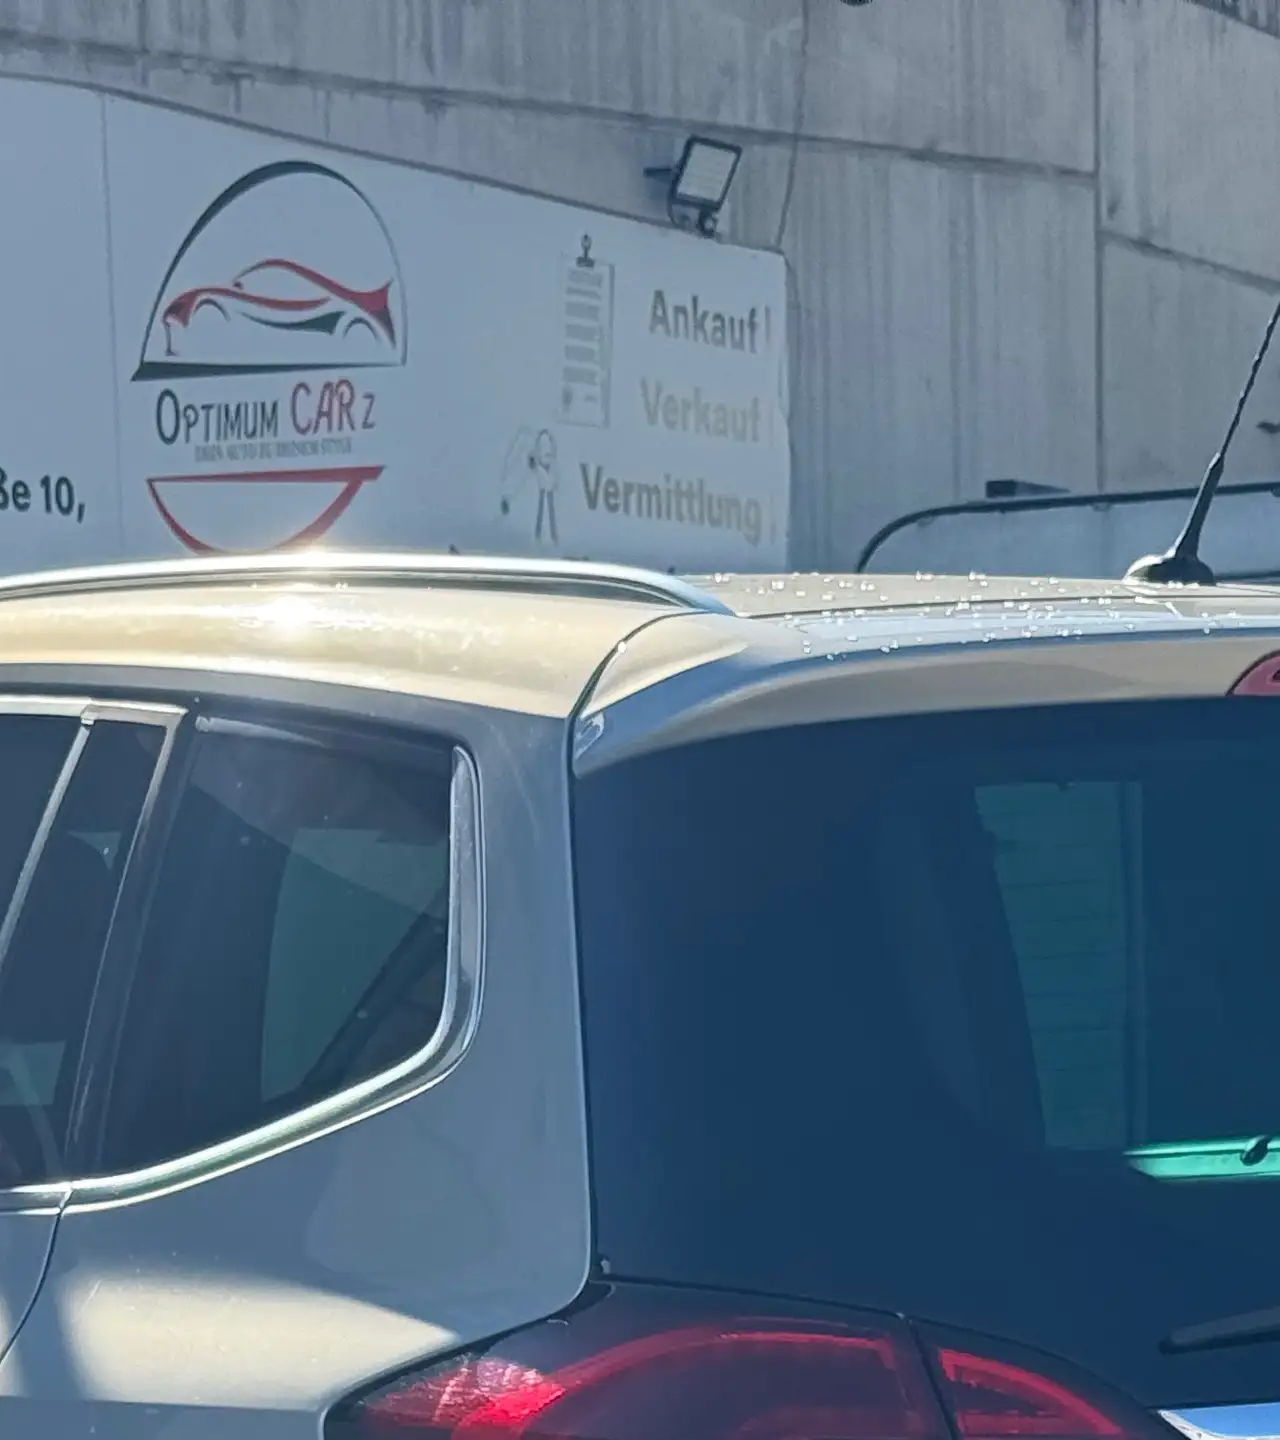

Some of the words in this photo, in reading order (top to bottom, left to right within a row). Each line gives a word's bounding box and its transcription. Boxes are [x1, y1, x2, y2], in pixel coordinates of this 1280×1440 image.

[648, 288, 759, 354] Ankauf
[640, 376, 760, 442] Verkauf
[39, 475, 86, 524] 10,
[578, 461, 763, 547] Vermittlung
